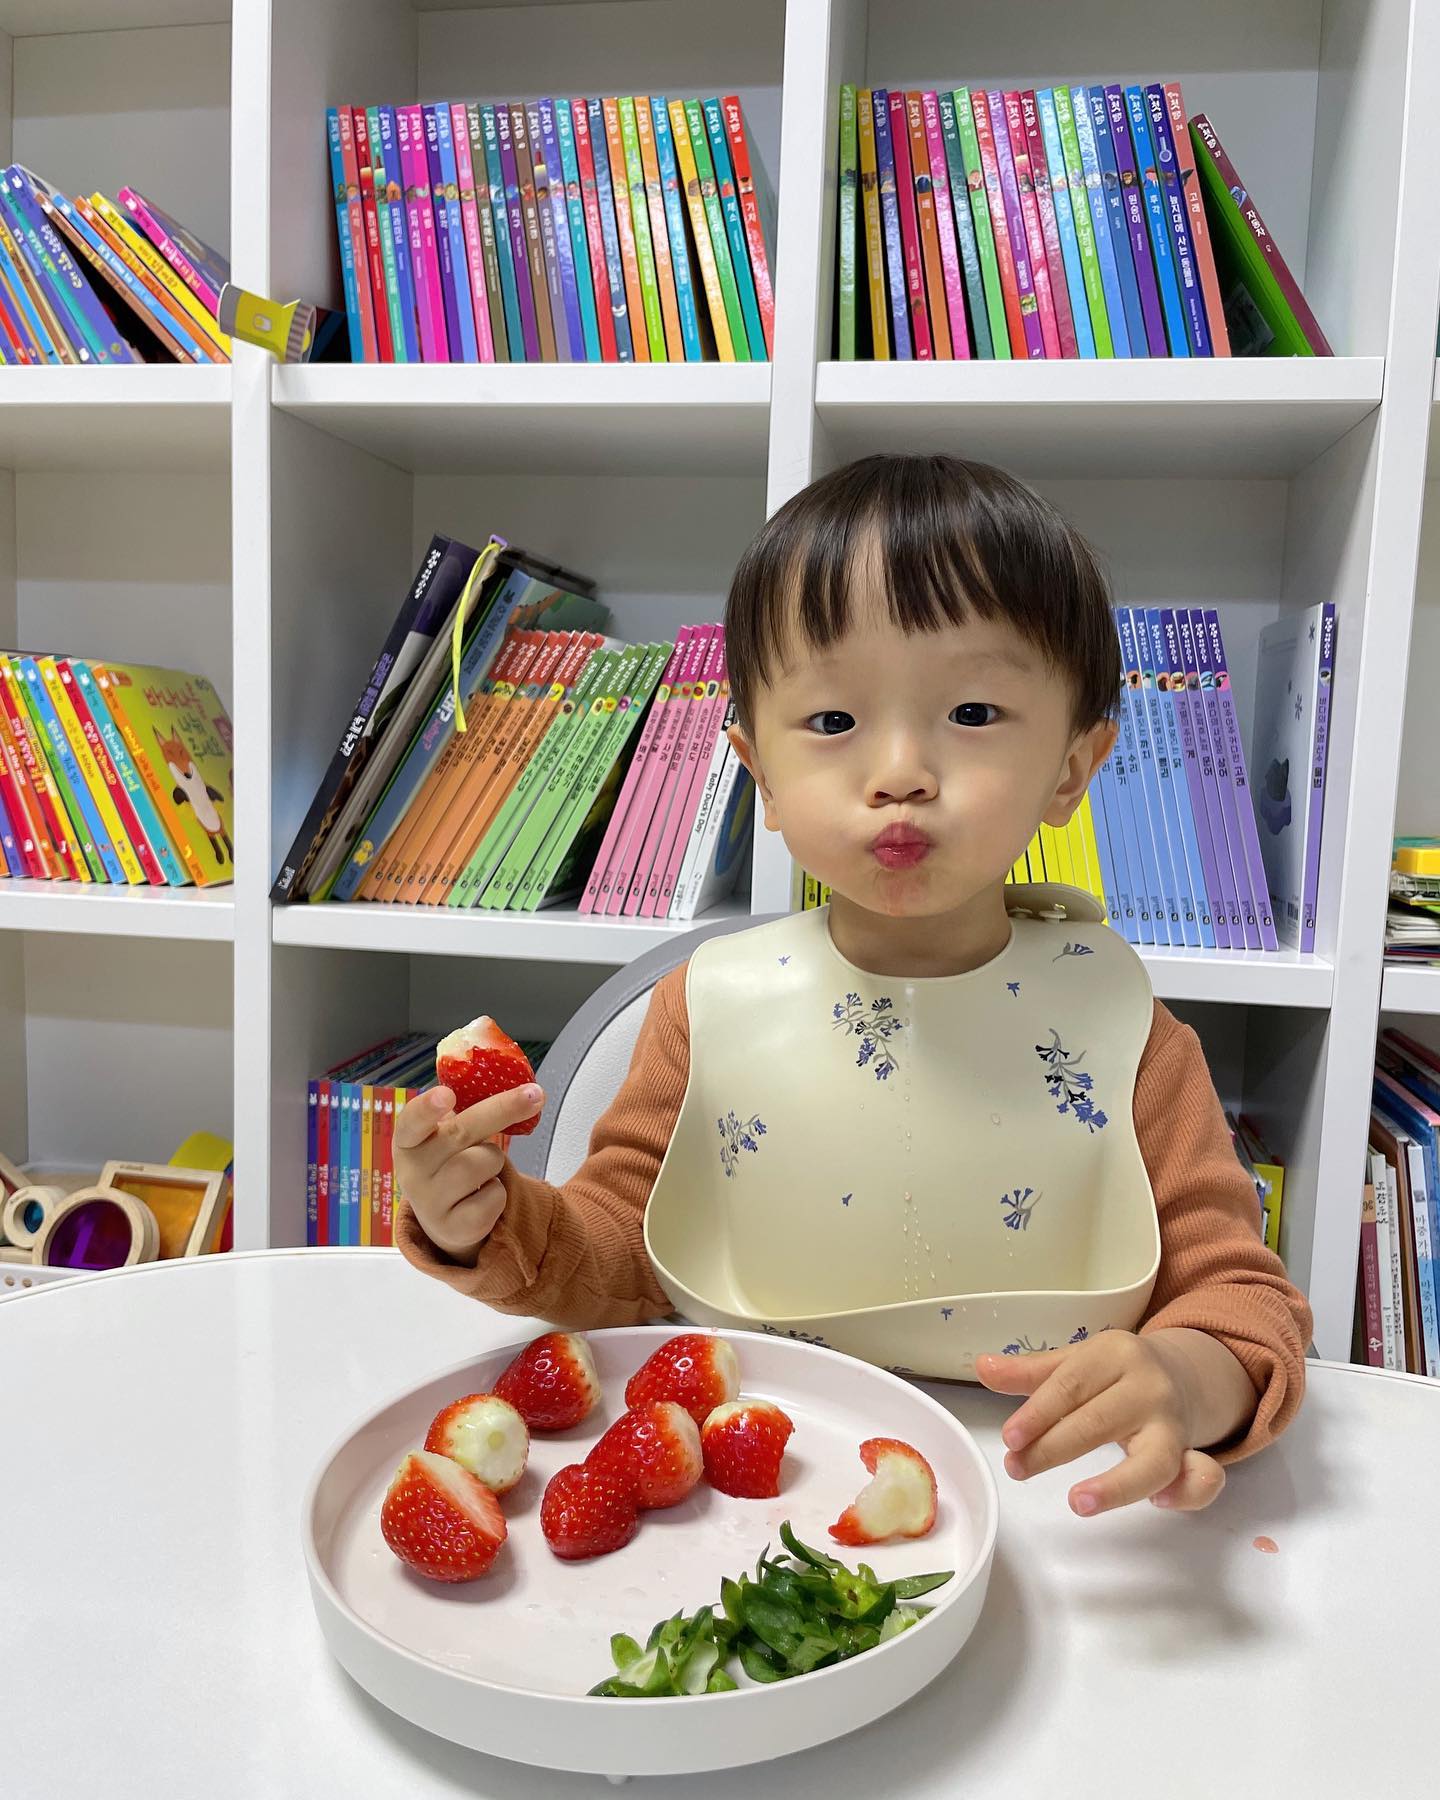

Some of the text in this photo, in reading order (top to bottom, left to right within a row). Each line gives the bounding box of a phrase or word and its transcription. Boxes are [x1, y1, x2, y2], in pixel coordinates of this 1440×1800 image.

[1128, 195, 1141, 224] 원숭이
[1189, 193, 1201, 213] 고래
[1246, 210, 1266, 238] 자동차
[1169, 195, 1194, 289] 늪지대에 사는 동물들
[1156, 737, 1164, 754] 사는
[1184, 729, 1192, 746] 주인
[1140, 740, 1151, 759] 까치
[1186, 750, 1195, 759] 게
[1114, 755, 1127, 786] 갈매기
[1128, 753, 1138, 773] 수리
[1173, 758, 1182, 768] 닭
[1202, 756, 1213, 776] 문어
[1218, 757, 1228, 777] 상어
[1229, 736, 1239, 763] 커다란
[1234, 766, 1246, 787] 고래
[694, 772, 718, 833] Baby Duck's Day
[1416, 1217, 1428, 1237] 마중
[1421, 1280, 1432, 1301] 마중
